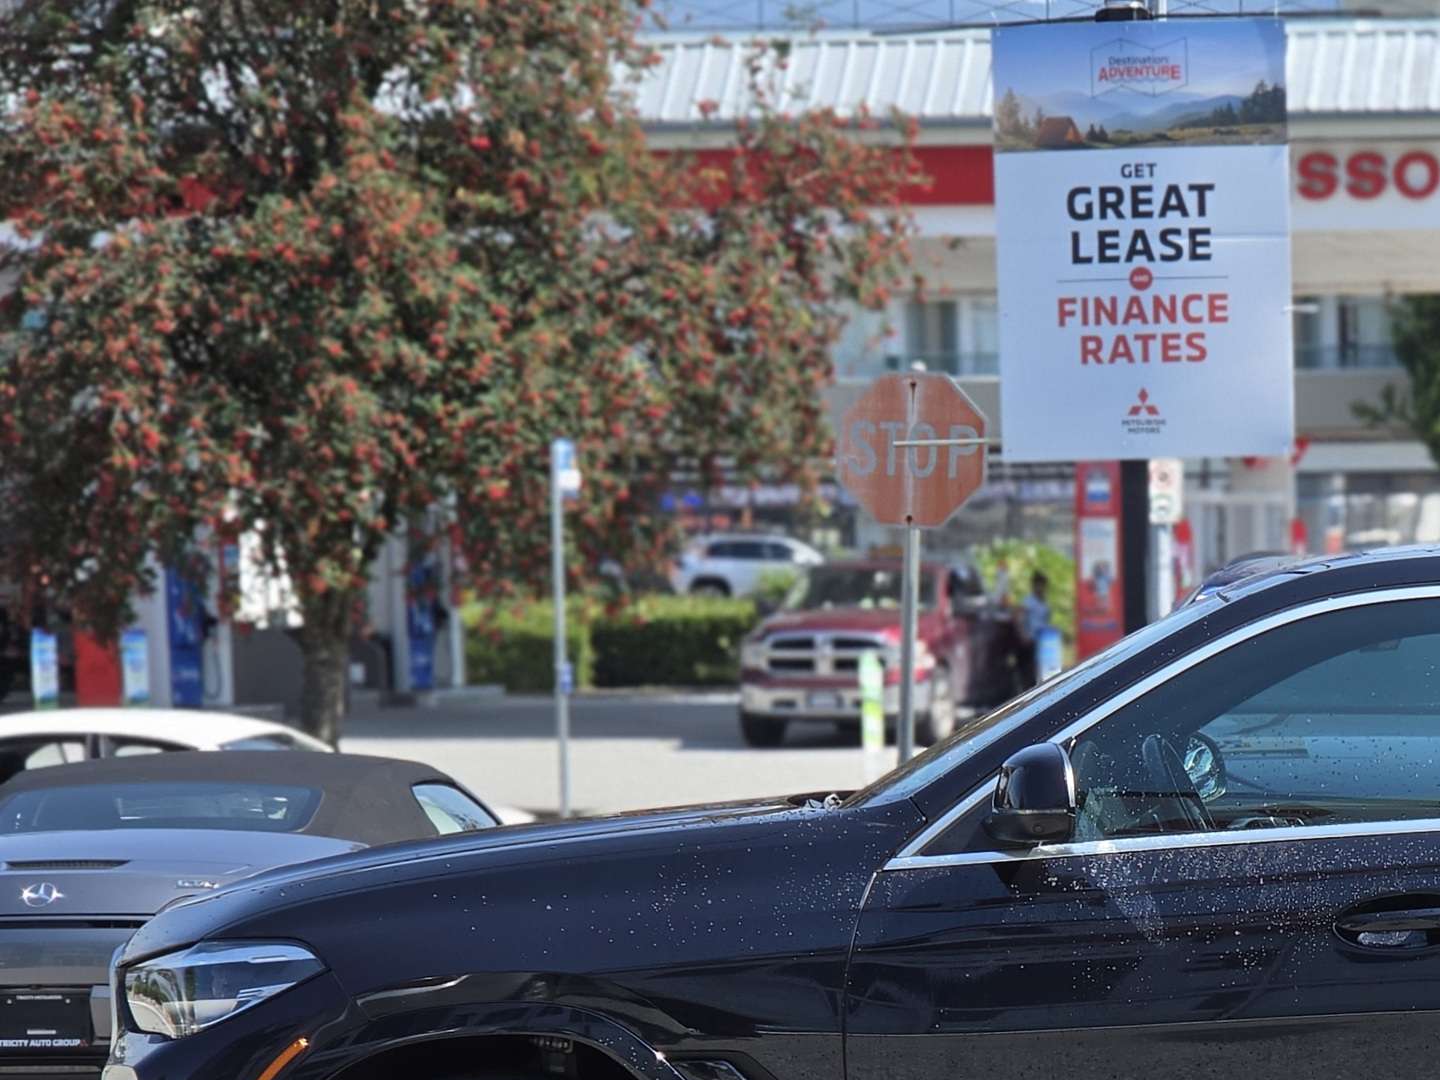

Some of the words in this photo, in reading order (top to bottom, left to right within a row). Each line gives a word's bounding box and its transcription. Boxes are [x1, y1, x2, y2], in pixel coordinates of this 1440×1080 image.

[1098, 64, 1181, 81] ADVENTURE
[1108, 56, 1169, 66] Destination
[1121, 163, 1157, 179] GET
[1066, 183, 1215, 221] GREAT
[1071, 227, 1212, 264] LEASE
[1057, 293, 1229, 327] FINANCE
[1080, 332, 1208, 365] RATES
[848, 420, 979, 480] STOP
[29, 1039, 51, 1048] AUTO
[52, 1039, 80, 1048] GROUP
